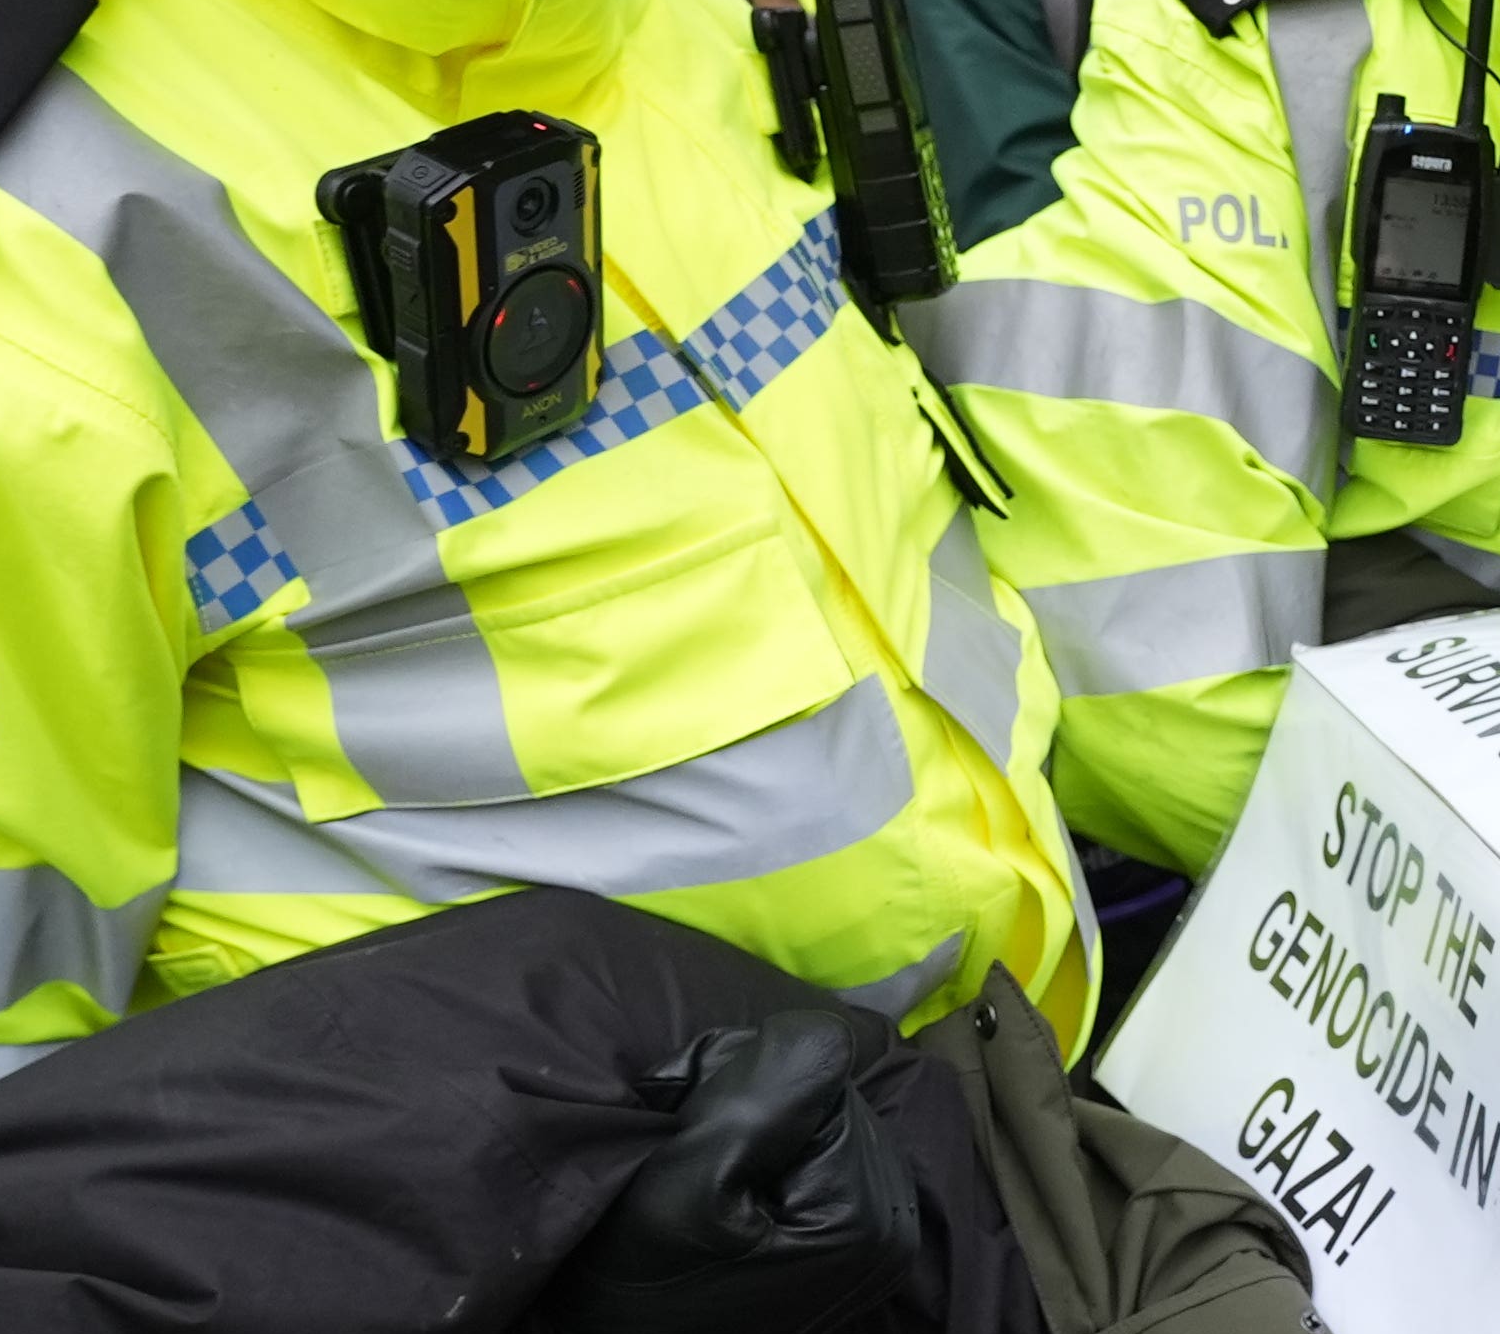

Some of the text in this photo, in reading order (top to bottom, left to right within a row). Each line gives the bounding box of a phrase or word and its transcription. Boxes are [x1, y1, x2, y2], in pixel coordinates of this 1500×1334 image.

[1248, 888, 1457, 1156] GENOCIDE
[1322, 779, 1497, 1027] STOP THE
[1235, 1076, 1397, 1268] GAZA!
